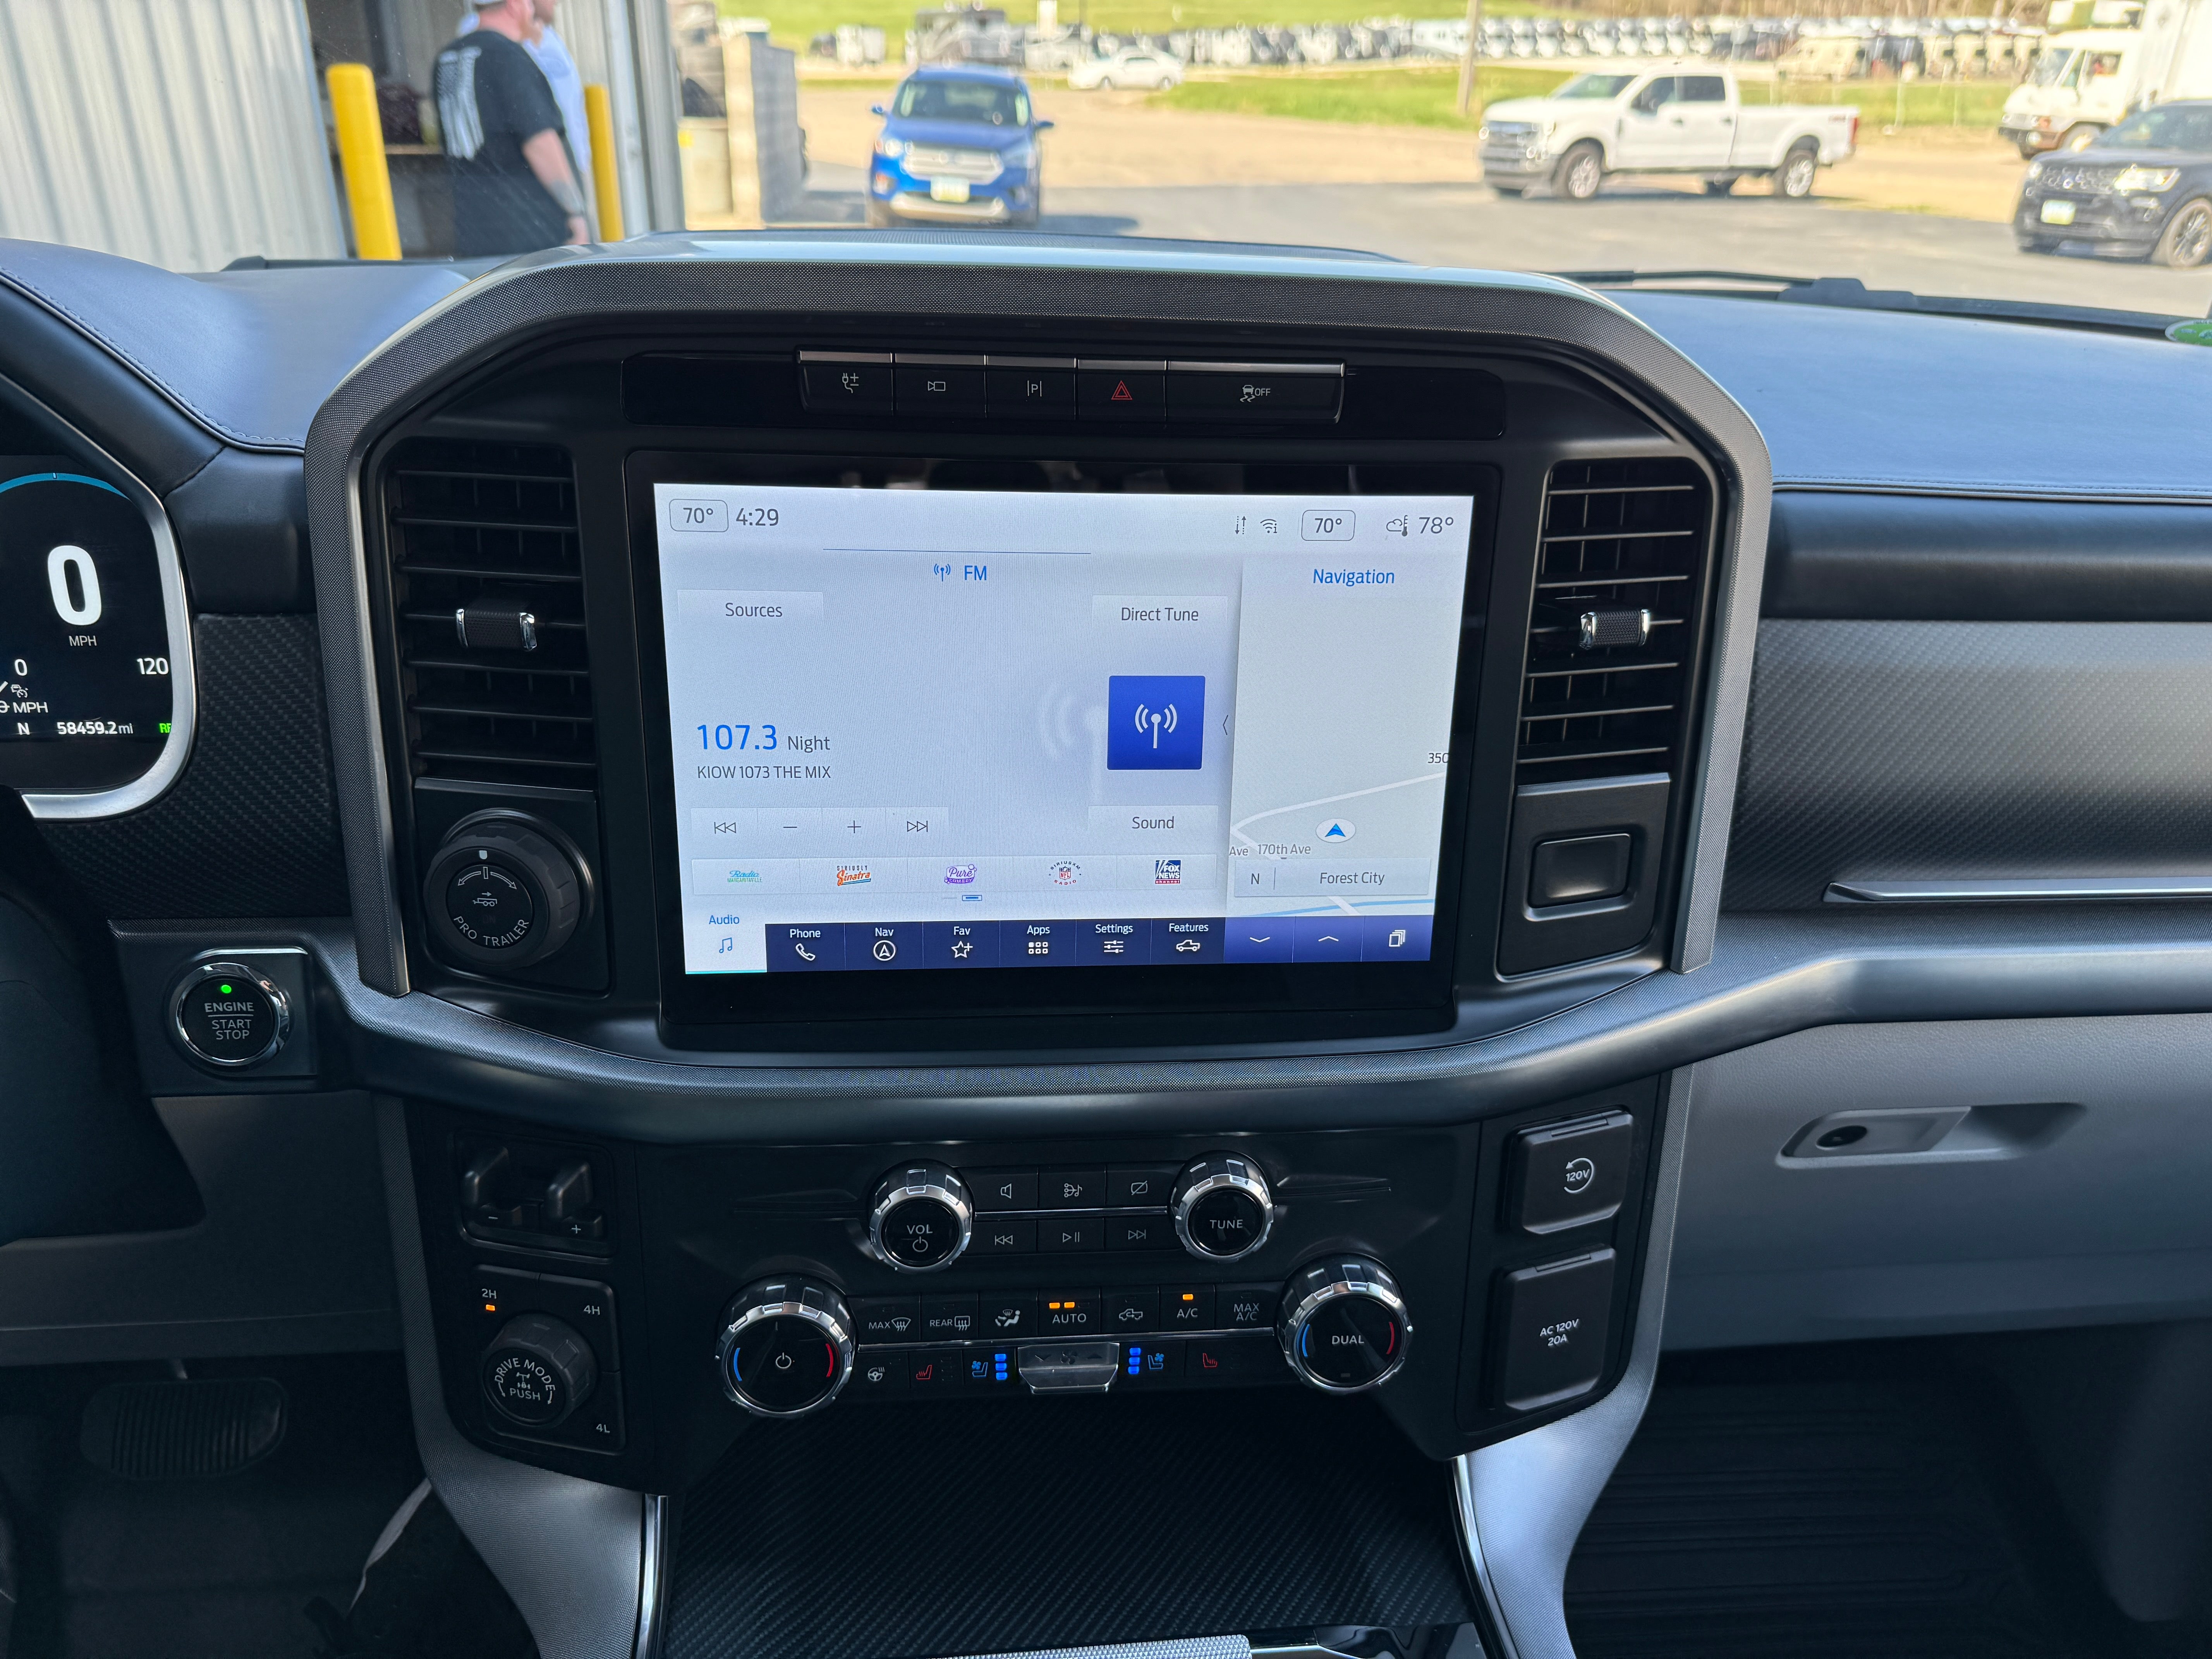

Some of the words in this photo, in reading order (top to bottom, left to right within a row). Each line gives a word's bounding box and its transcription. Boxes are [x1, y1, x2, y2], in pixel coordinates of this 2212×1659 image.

[1255, 387, 1271, 397] OFF
[683, 507, 713, 524] 70°
[735, 508, 779, 527] 4:29
[1315, 518, 1342, 533] 70°
[1419, 516, 1454, 535] 78°
[963, 565, 988, 581] FM
[1312, 568, 1395, 587] Navigation
[47, 545, 102, 625] 0
[725, 602, 783, 618] Sources
[1121, 607, 1161, 622] Direct
[1164, 607, 1199, 622] Tune
[69, 635, 97, 646] MPH
[15, 659, 27, 676] 0
[137, 658, 169, 675] 120
[13, 702, 48, 713] MPH
[17, 722, 30, 735] N
[697, 724, 778, 750] 107.3
[787, 735, 831, 753] Night
[1428, 753, 1449, 763] 350
[697, 766, 736, 779] KIOW
[739, 766, 771, 779] 1073
[773, 766, 802, 778] THE
[805, 766, 831, 778] MIX
[1132, 816, 1175, 830] Sound
[1229, 846, 1249, 856] Ave
[1257, 843, 1288, 855] 170th
[1290, 844, 1311, 854] Ave
[836, 870, 871, 886] Sinatra
[949, 867, 973, 877] Pure
[1251, 873, 1260, 885] N
[1320, 872, 1358, 884] Forest
[1361, 872, 1385, 886] City
[709, 914, 740, 925] Audio
[453, 915, 477, 939] PRO
[483, 919, 529, 946] TRAILER
[789, 928, 821, 939] Phone
[874, 927, 894, 938] Nav
[953, 926, 971, 936] Fav
[1026, 925, 1051, 937] Apps
[1095, 923, 1133, 935] Settings
[1168, 922, 1209, 933] Features
[204, 1002, 254, 1012] ENGINE
[212, 1019, 252, 1029] START
[216, 1030, 250, 1040] STOP
[1565, 1169, 1590, 1182] 120V
[907, 1224, 933, 1235] VOL
[1209, 1218, 1244, 1230] TUNE
[481, 1288, 497, 1300] 2H
[583, 1304, 601, 1316] 4H
[1176, 1307, 1198, 1318] A/C
[1233, 1303, 1260, 1313] MAX
[1052, 1314, 1087, 1325] AUTO
[1236, 1310, 1258, 1321] A/C
[869, 1321, 890, 1329] MAX
[1539, 1325, 1555, 1337] AC
[1555, 1318, 1580, 1333] 120V
[1331, 1335, 1364, 1345] DUAL
[1547, 1334, 1568, 1346] 20A
[494, 1357, 521, 1384] DRIVE
[524, 1358, 556, 1392] MODE
[509, 1388, 541, 1401] PUSH
[596, 1423, 610, 1434] 4L
